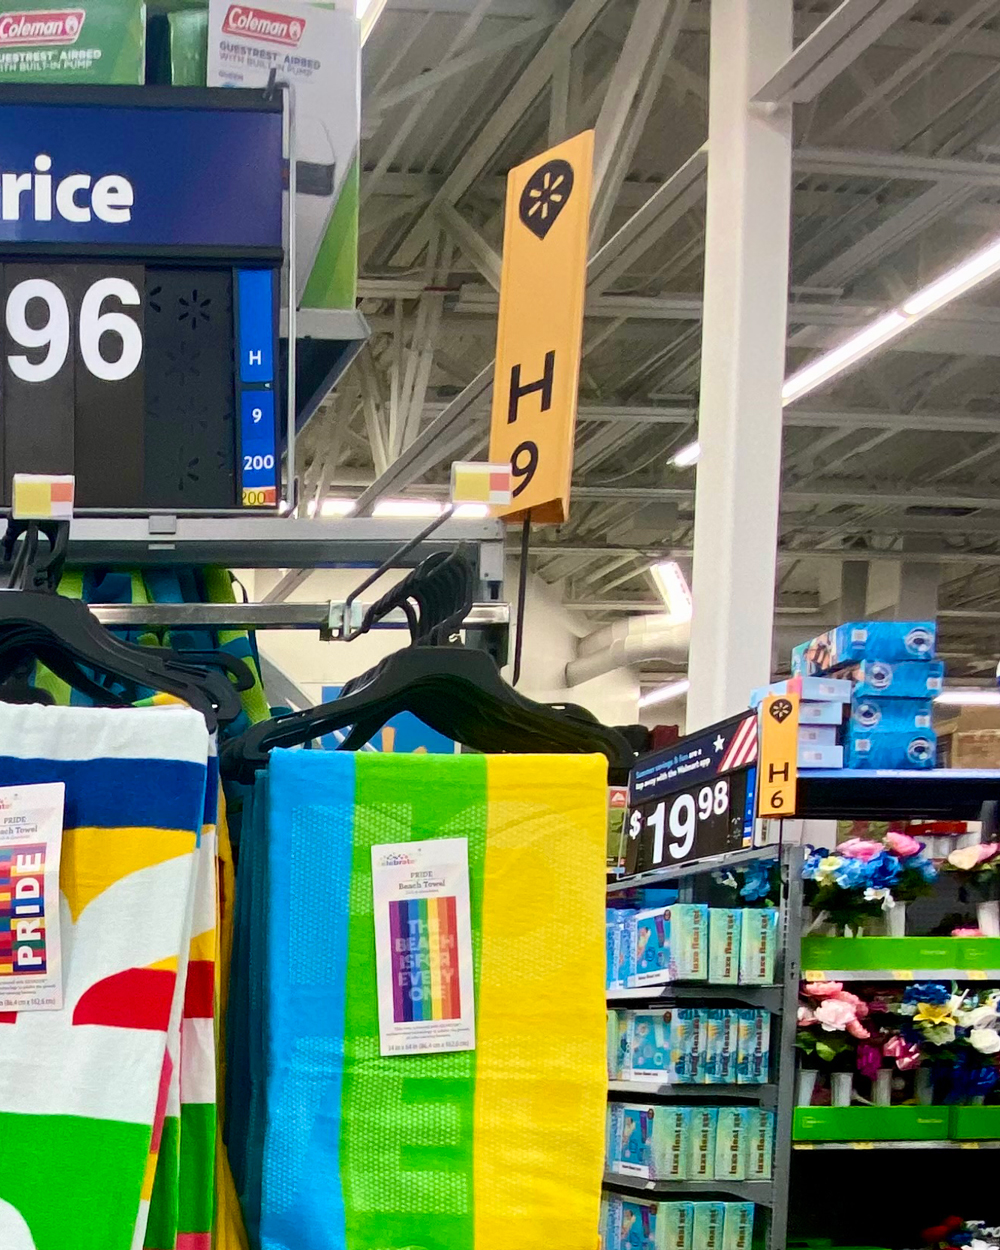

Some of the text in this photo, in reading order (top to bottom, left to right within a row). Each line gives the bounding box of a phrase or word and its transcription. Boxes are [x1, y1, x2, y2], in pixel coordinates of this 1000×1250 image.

[0, 13, 63, 38] Coleman
[229, 8, 288, 37] Coleman
[60, 49, 102, 60] AIRBED
[219, 41, 321, 70] GUESTREST AIRBED
[219, 52, 244, 64] WITH
[64, 59, 94, 69] PUMP
[249, 350, 262, 366] H
[507, 350, 556, 424] H
[252, 408, 263, 423] 9
[244, 455, 275, 471] 200
[511, 440, 539, 498] 9
[769, 762, 789, 783] H
[770, 790, 784, 809] 6
[3, 816, 26, 824] PRIDE
[15, 824, 38, 834] Towel
[410, 870, 433, 879] PRIDE
[398, 879, 446, 890] Beach Towel
[15, 852, 42, 966] PRIDE
[395, 934, 455, 953] BEACH
[398, 968, 454, 986] EVERY
